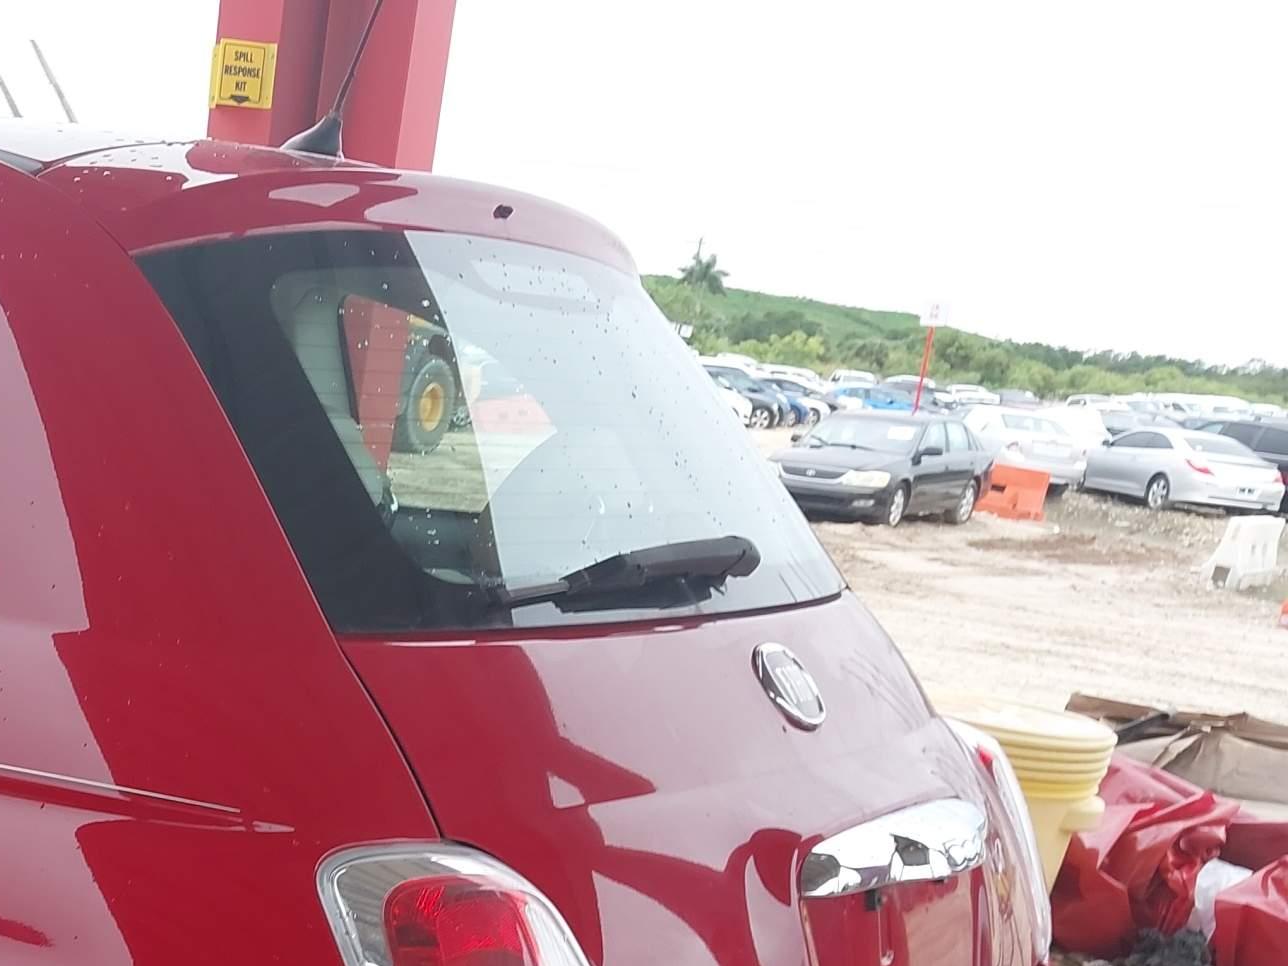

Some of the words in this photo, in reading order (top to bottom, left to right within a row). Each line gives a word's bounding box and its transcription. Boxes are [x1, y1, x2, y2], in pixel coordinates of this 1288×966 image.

[234, 50, 254, 63] SPILL
[224, 64, 261, 79] RESPONSE
[235, 81, 247, 92] KIT
